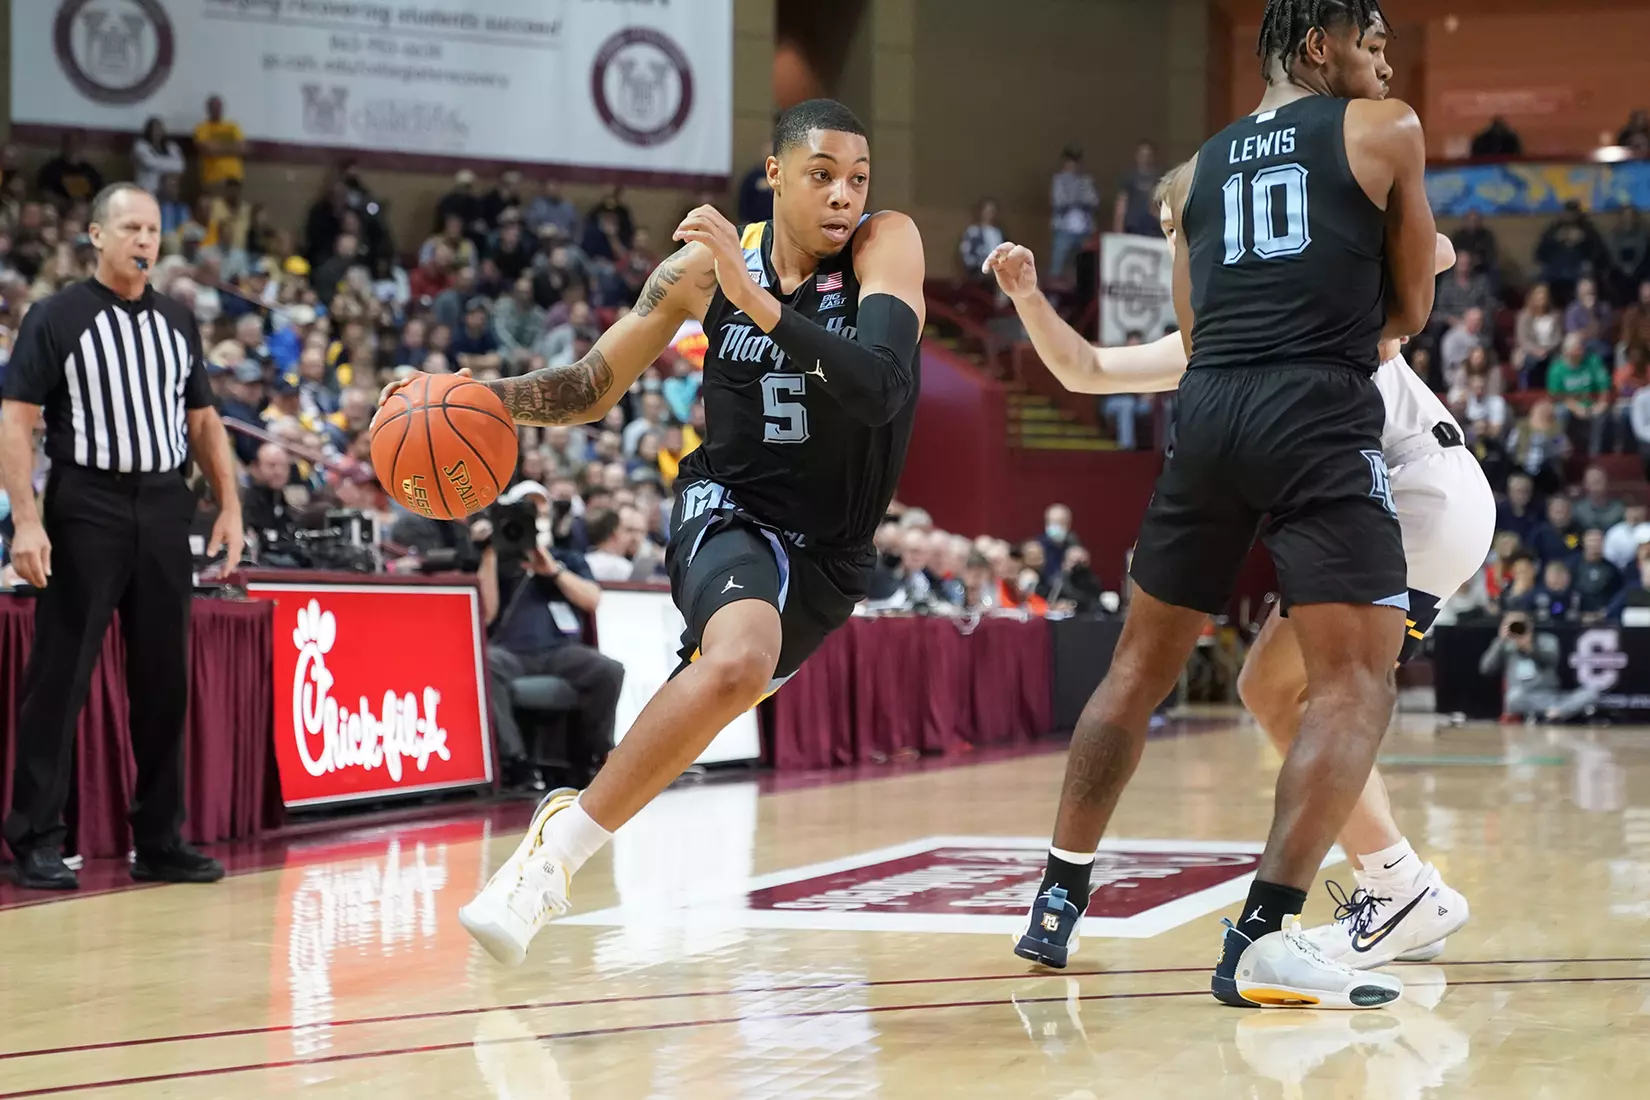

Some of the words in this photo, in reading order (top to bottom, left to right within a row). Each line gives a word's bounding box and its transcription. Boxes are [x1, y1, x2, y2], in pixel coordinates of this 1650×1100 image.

[1229, 127, 1296, 164] LEWIS
[1222, 163, 1312, 265] 10
[819, 297, 847, 309] EAST
[822, 292, 842, 301] BIG
[759, 372, 811, 445] 5
[293, 598, 451, 782] Chick-fil-A
